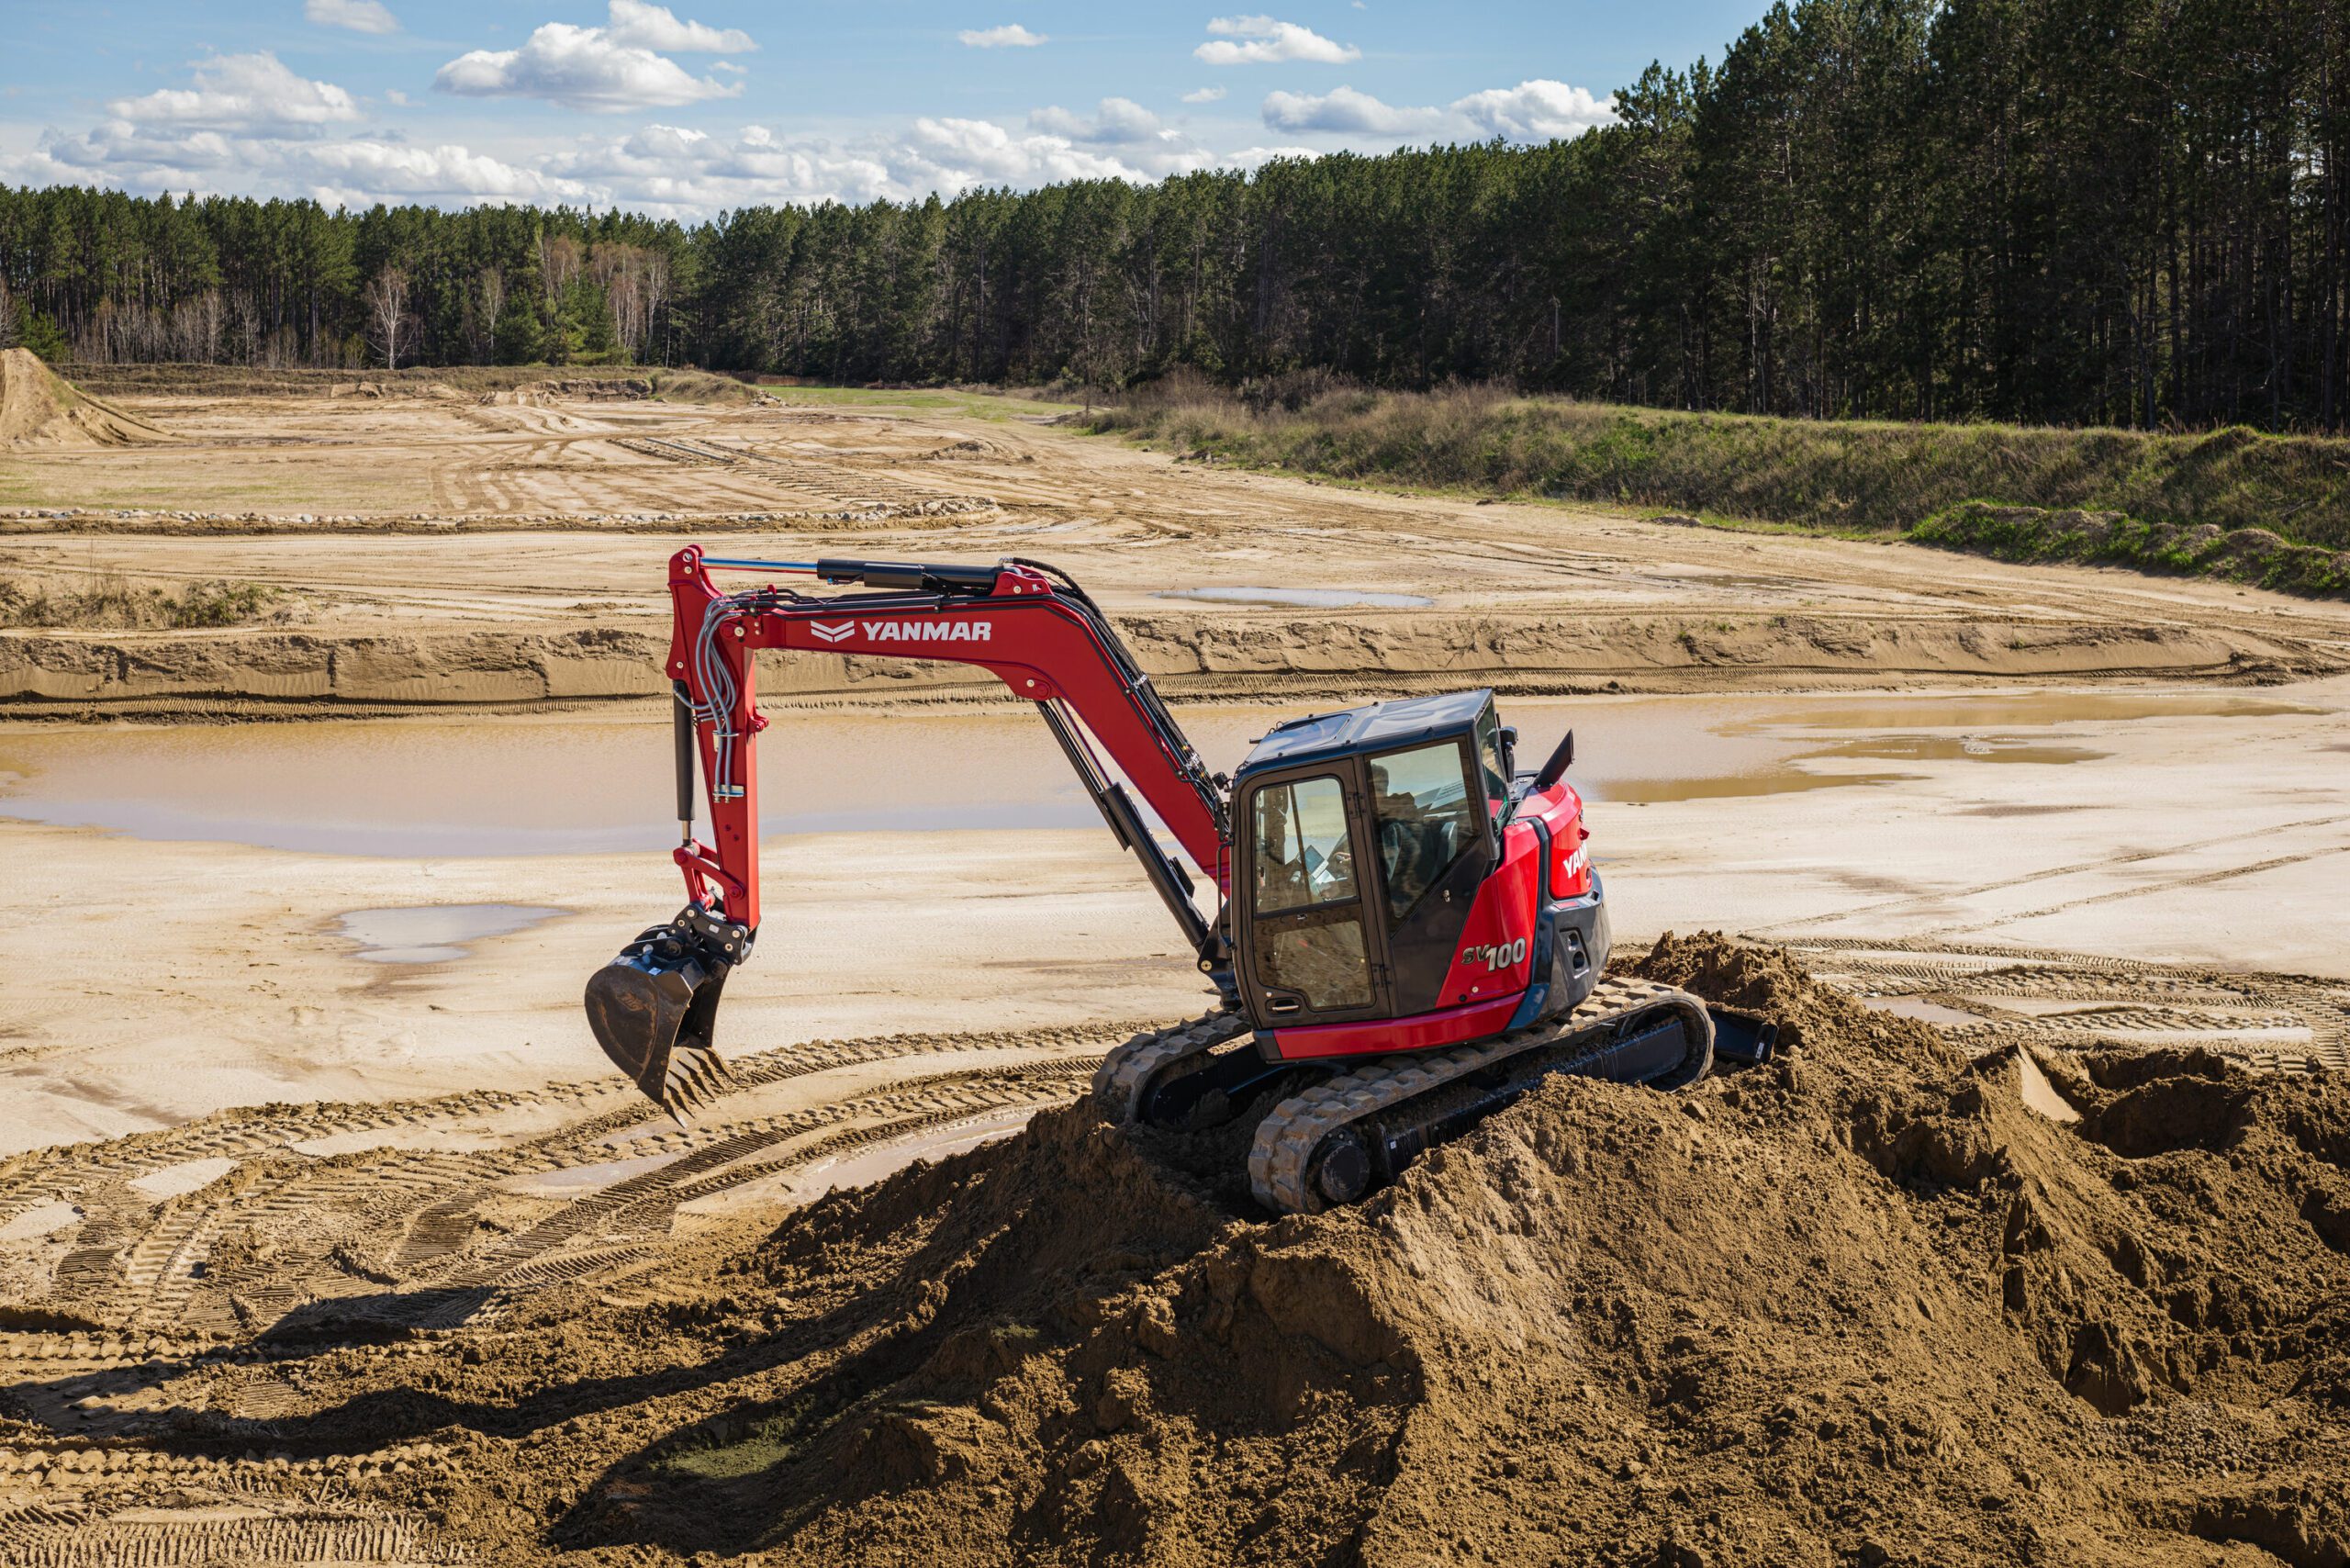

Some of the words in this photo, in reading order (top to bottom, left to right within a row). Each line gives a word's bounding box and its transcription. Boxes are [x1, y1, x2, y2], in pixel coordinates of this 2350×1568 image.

[862, 622, 991, 641] YANMAR
[1562, 840, 1588, 879] YAN
[1461, 937, 1526, 971] SV100
